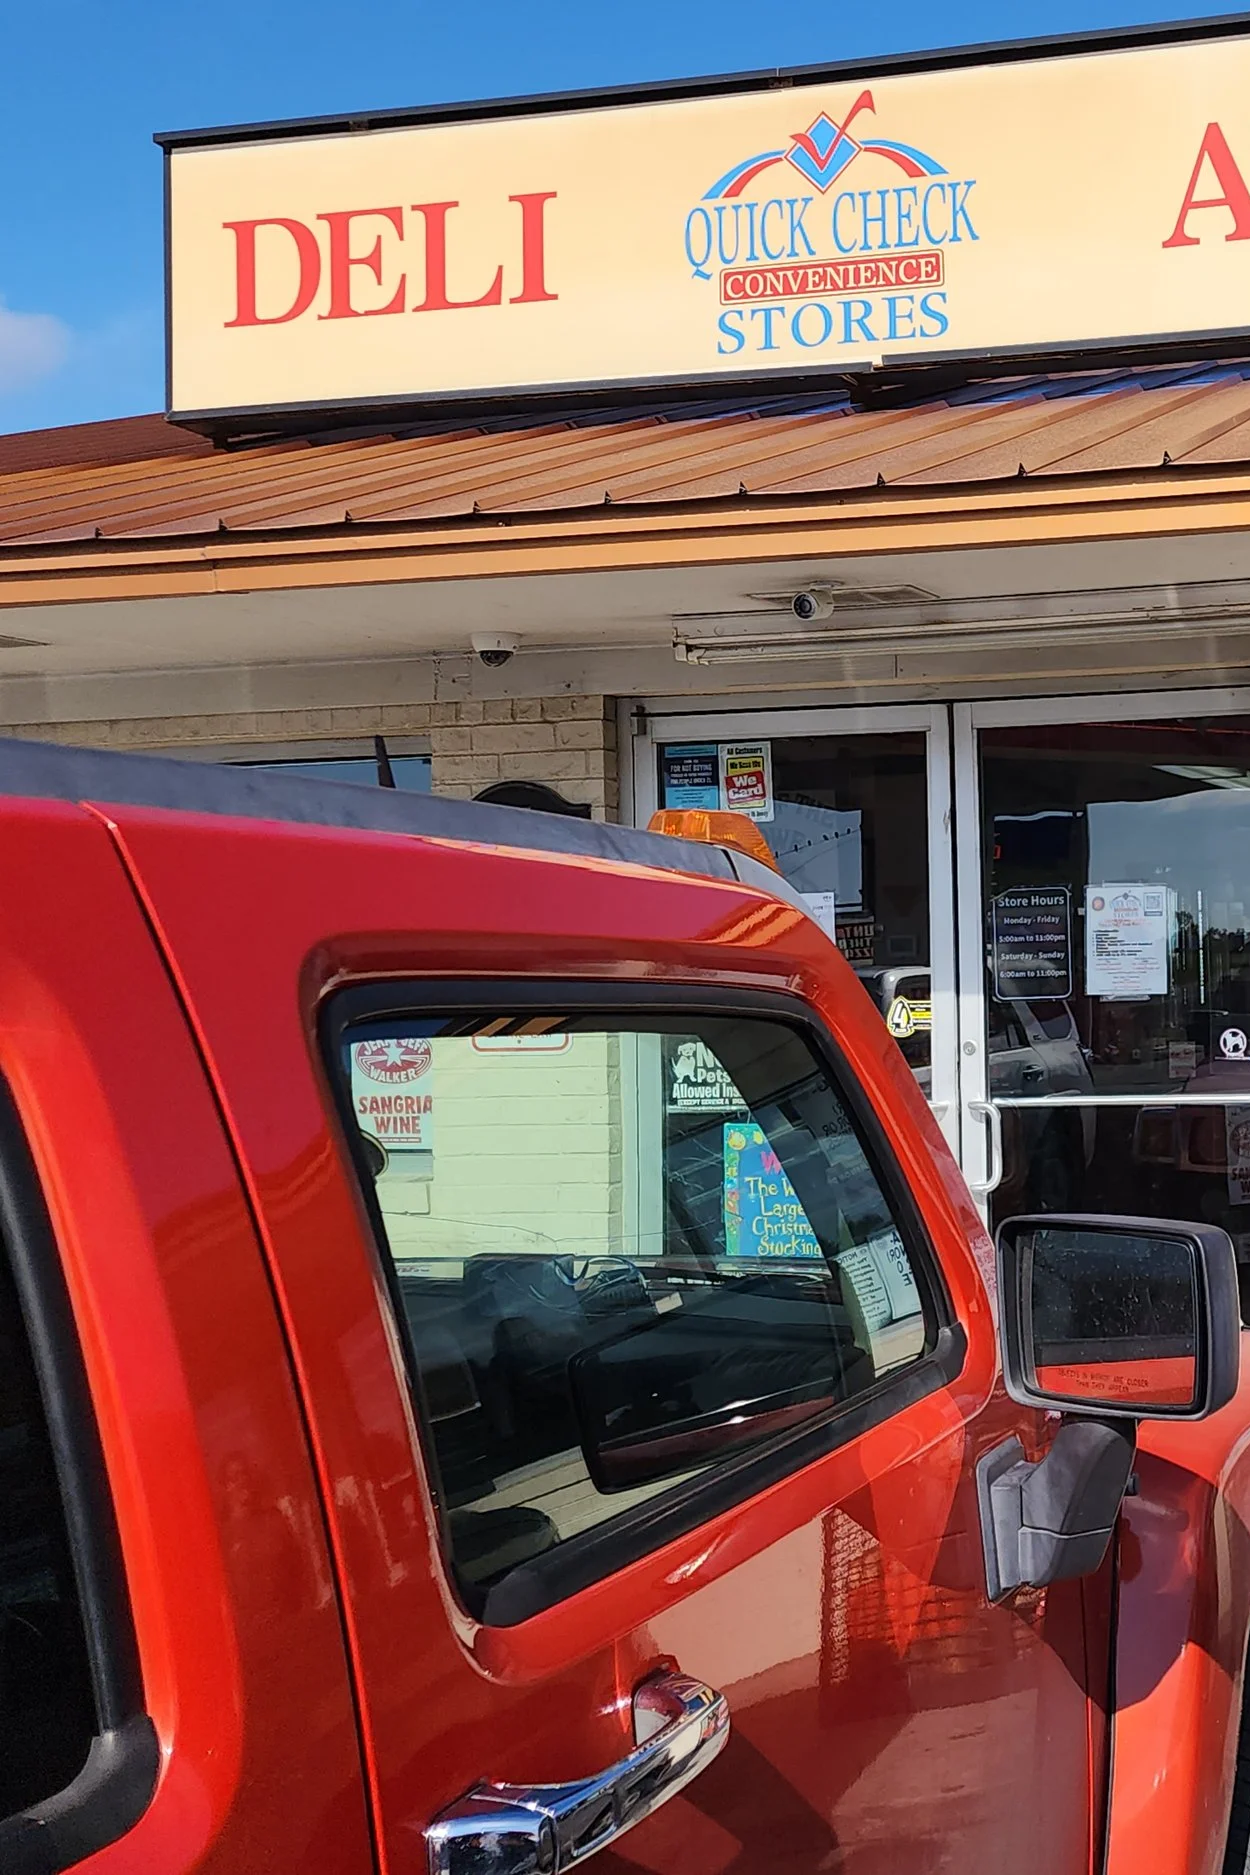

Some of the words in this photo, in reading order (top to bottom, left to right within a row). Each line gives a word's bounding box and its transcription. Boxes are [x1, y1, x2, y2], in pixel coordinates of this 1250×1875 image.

[685, 196, 816, 281] QUICK
[832, 179, 980, 254] CHECK
[222, 191, 558, 328] DELI
[725, 256, 938, 299] CONVENIENCE
[717, 292, 949, 355] STORES
[732, 775, 757, 787] We
[728, 783, 764, 799] Card
[998, 896, 1028, 907] Store
[1031, 895, 1065, 906] Hours
[1003, 916, 1032, 926] Monday
[1037, 915, 1061, 924] Friday
[1001, 952, 1033, 961] Saturday
[1038, 951, 1065, 960] Sunday
[368, 1067, 418, 1083] WALKER
[697, 1068, 732, 1084] Pets
[672, 1082, 720, 1099] Allowed
[358, 1095, 433, 1115] SANGRIA
[374, 1115, 421, 1134] WINE
[744, 1177, 778, 1197] The
